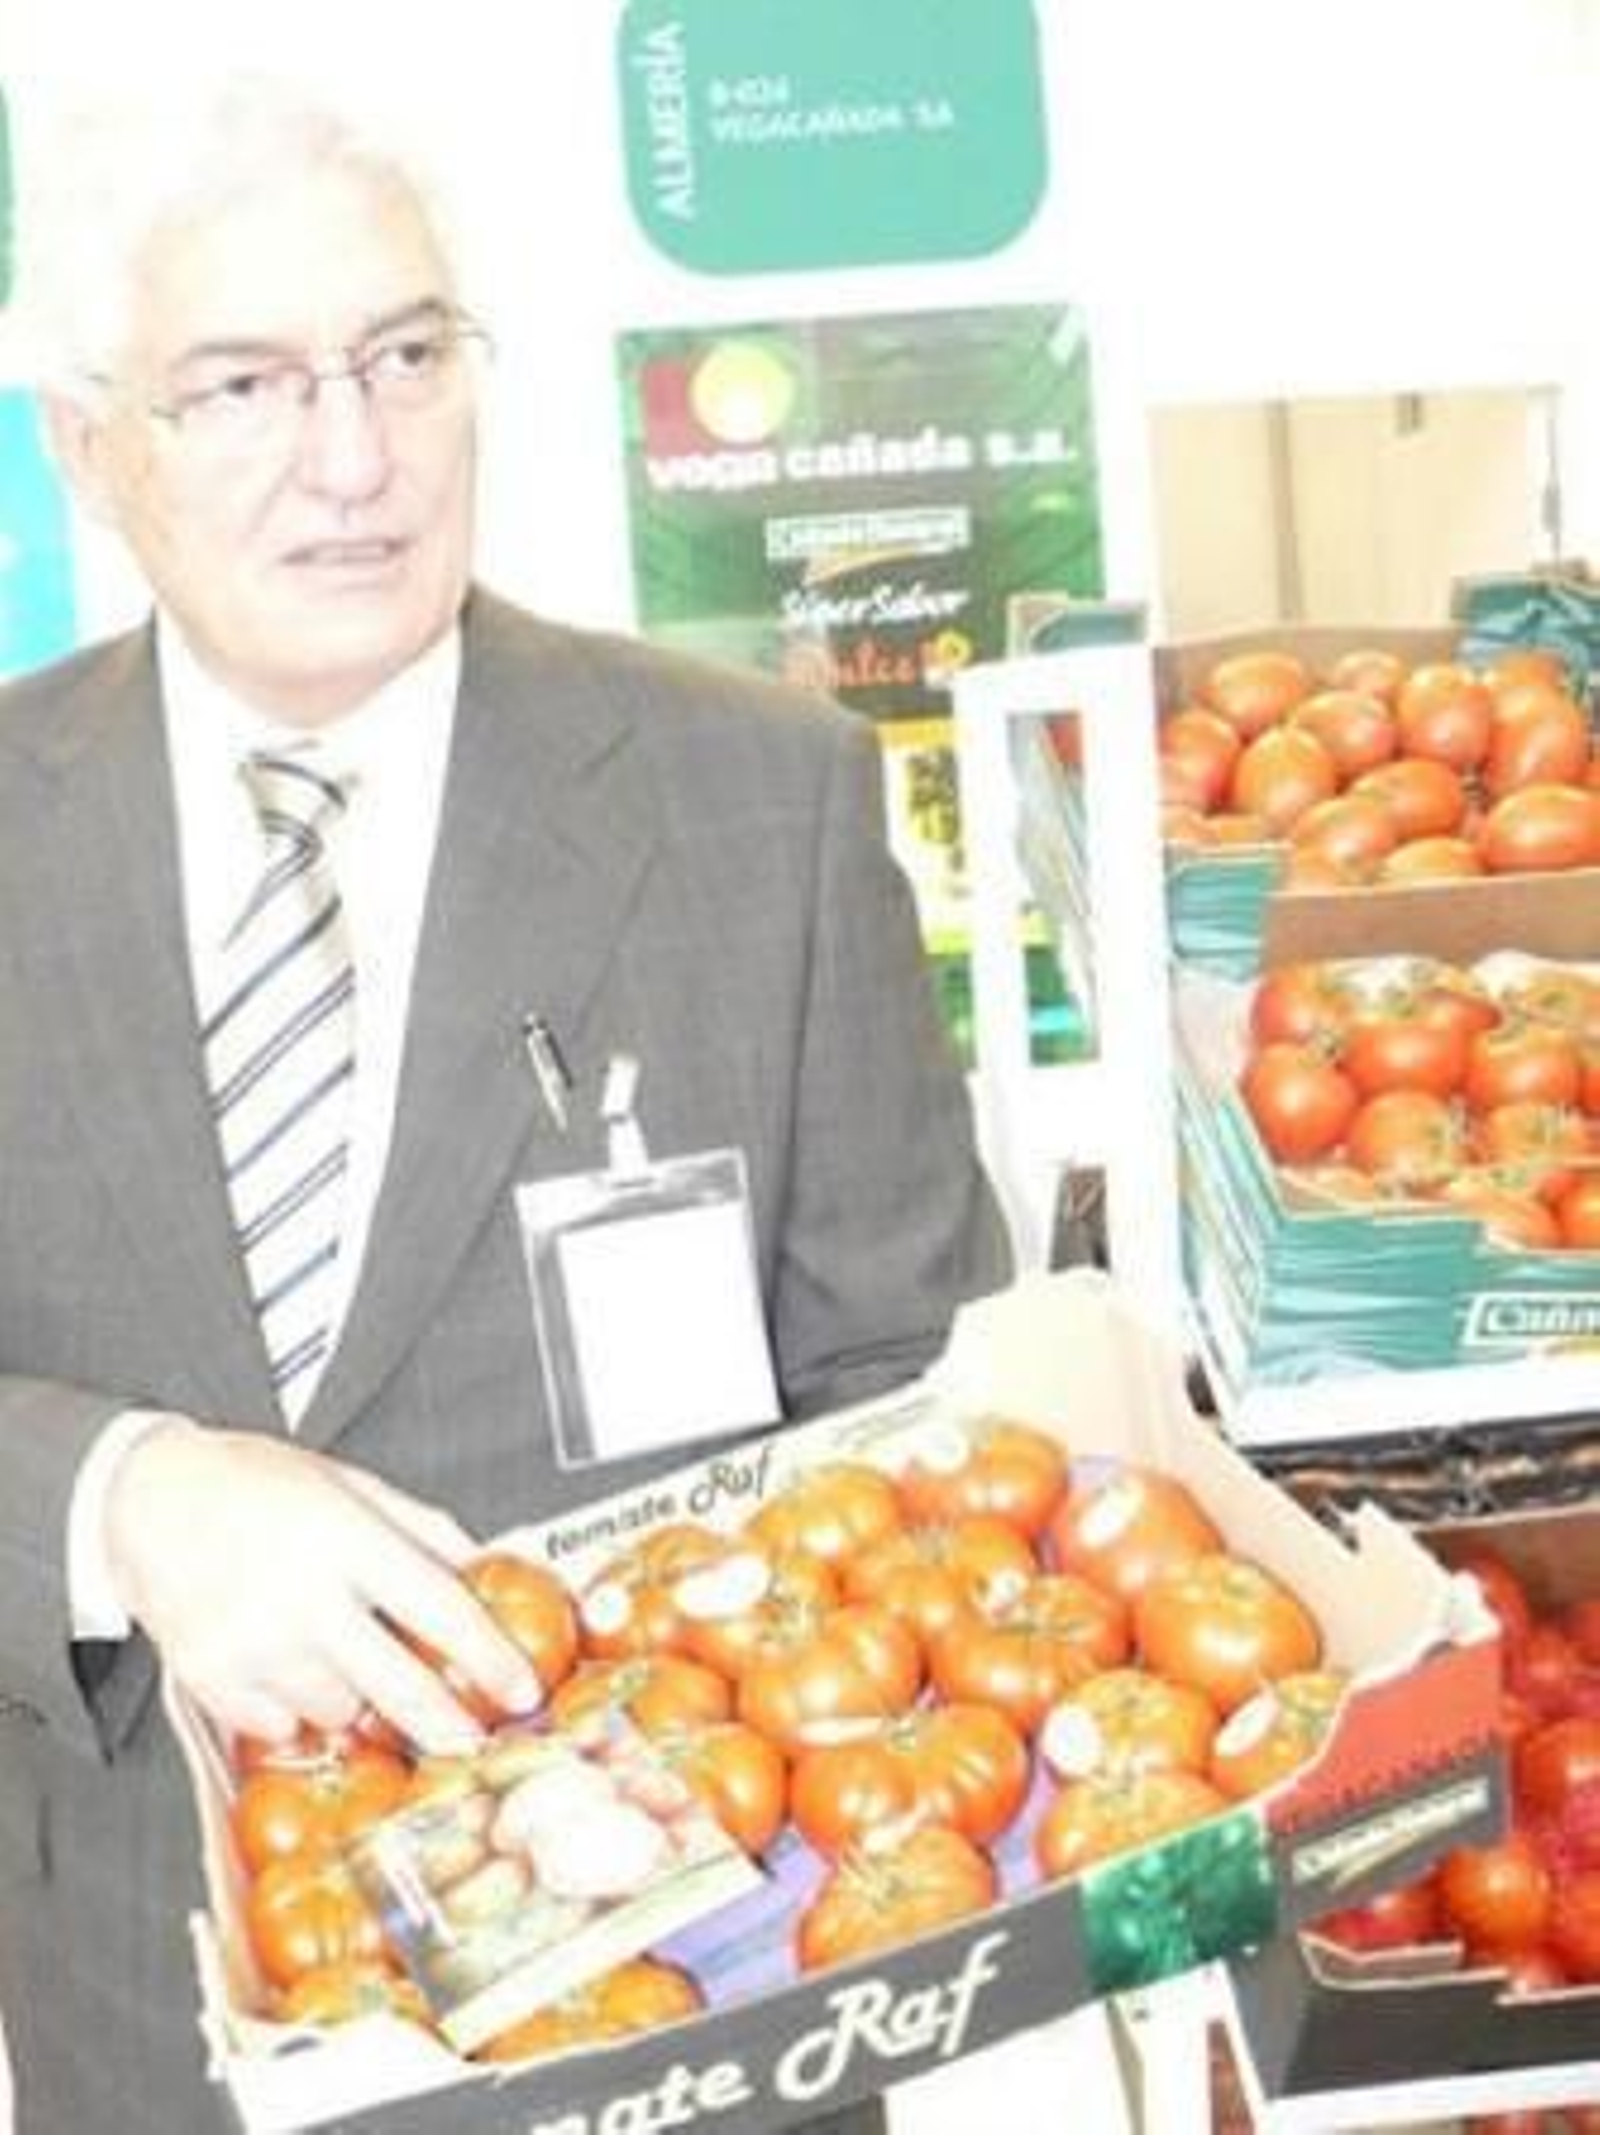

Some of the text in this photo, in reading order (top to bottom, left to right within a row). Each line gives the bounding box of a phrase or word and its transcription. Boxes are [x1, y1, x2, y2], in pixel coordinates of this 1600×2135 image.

[631, 22, 696, 221] ALMERÍA
[785, 425, 972, 480] cañada
[545, 1438, 772, 1562] tomate Raf
[775, 1931, 1010, 2101] Raf
